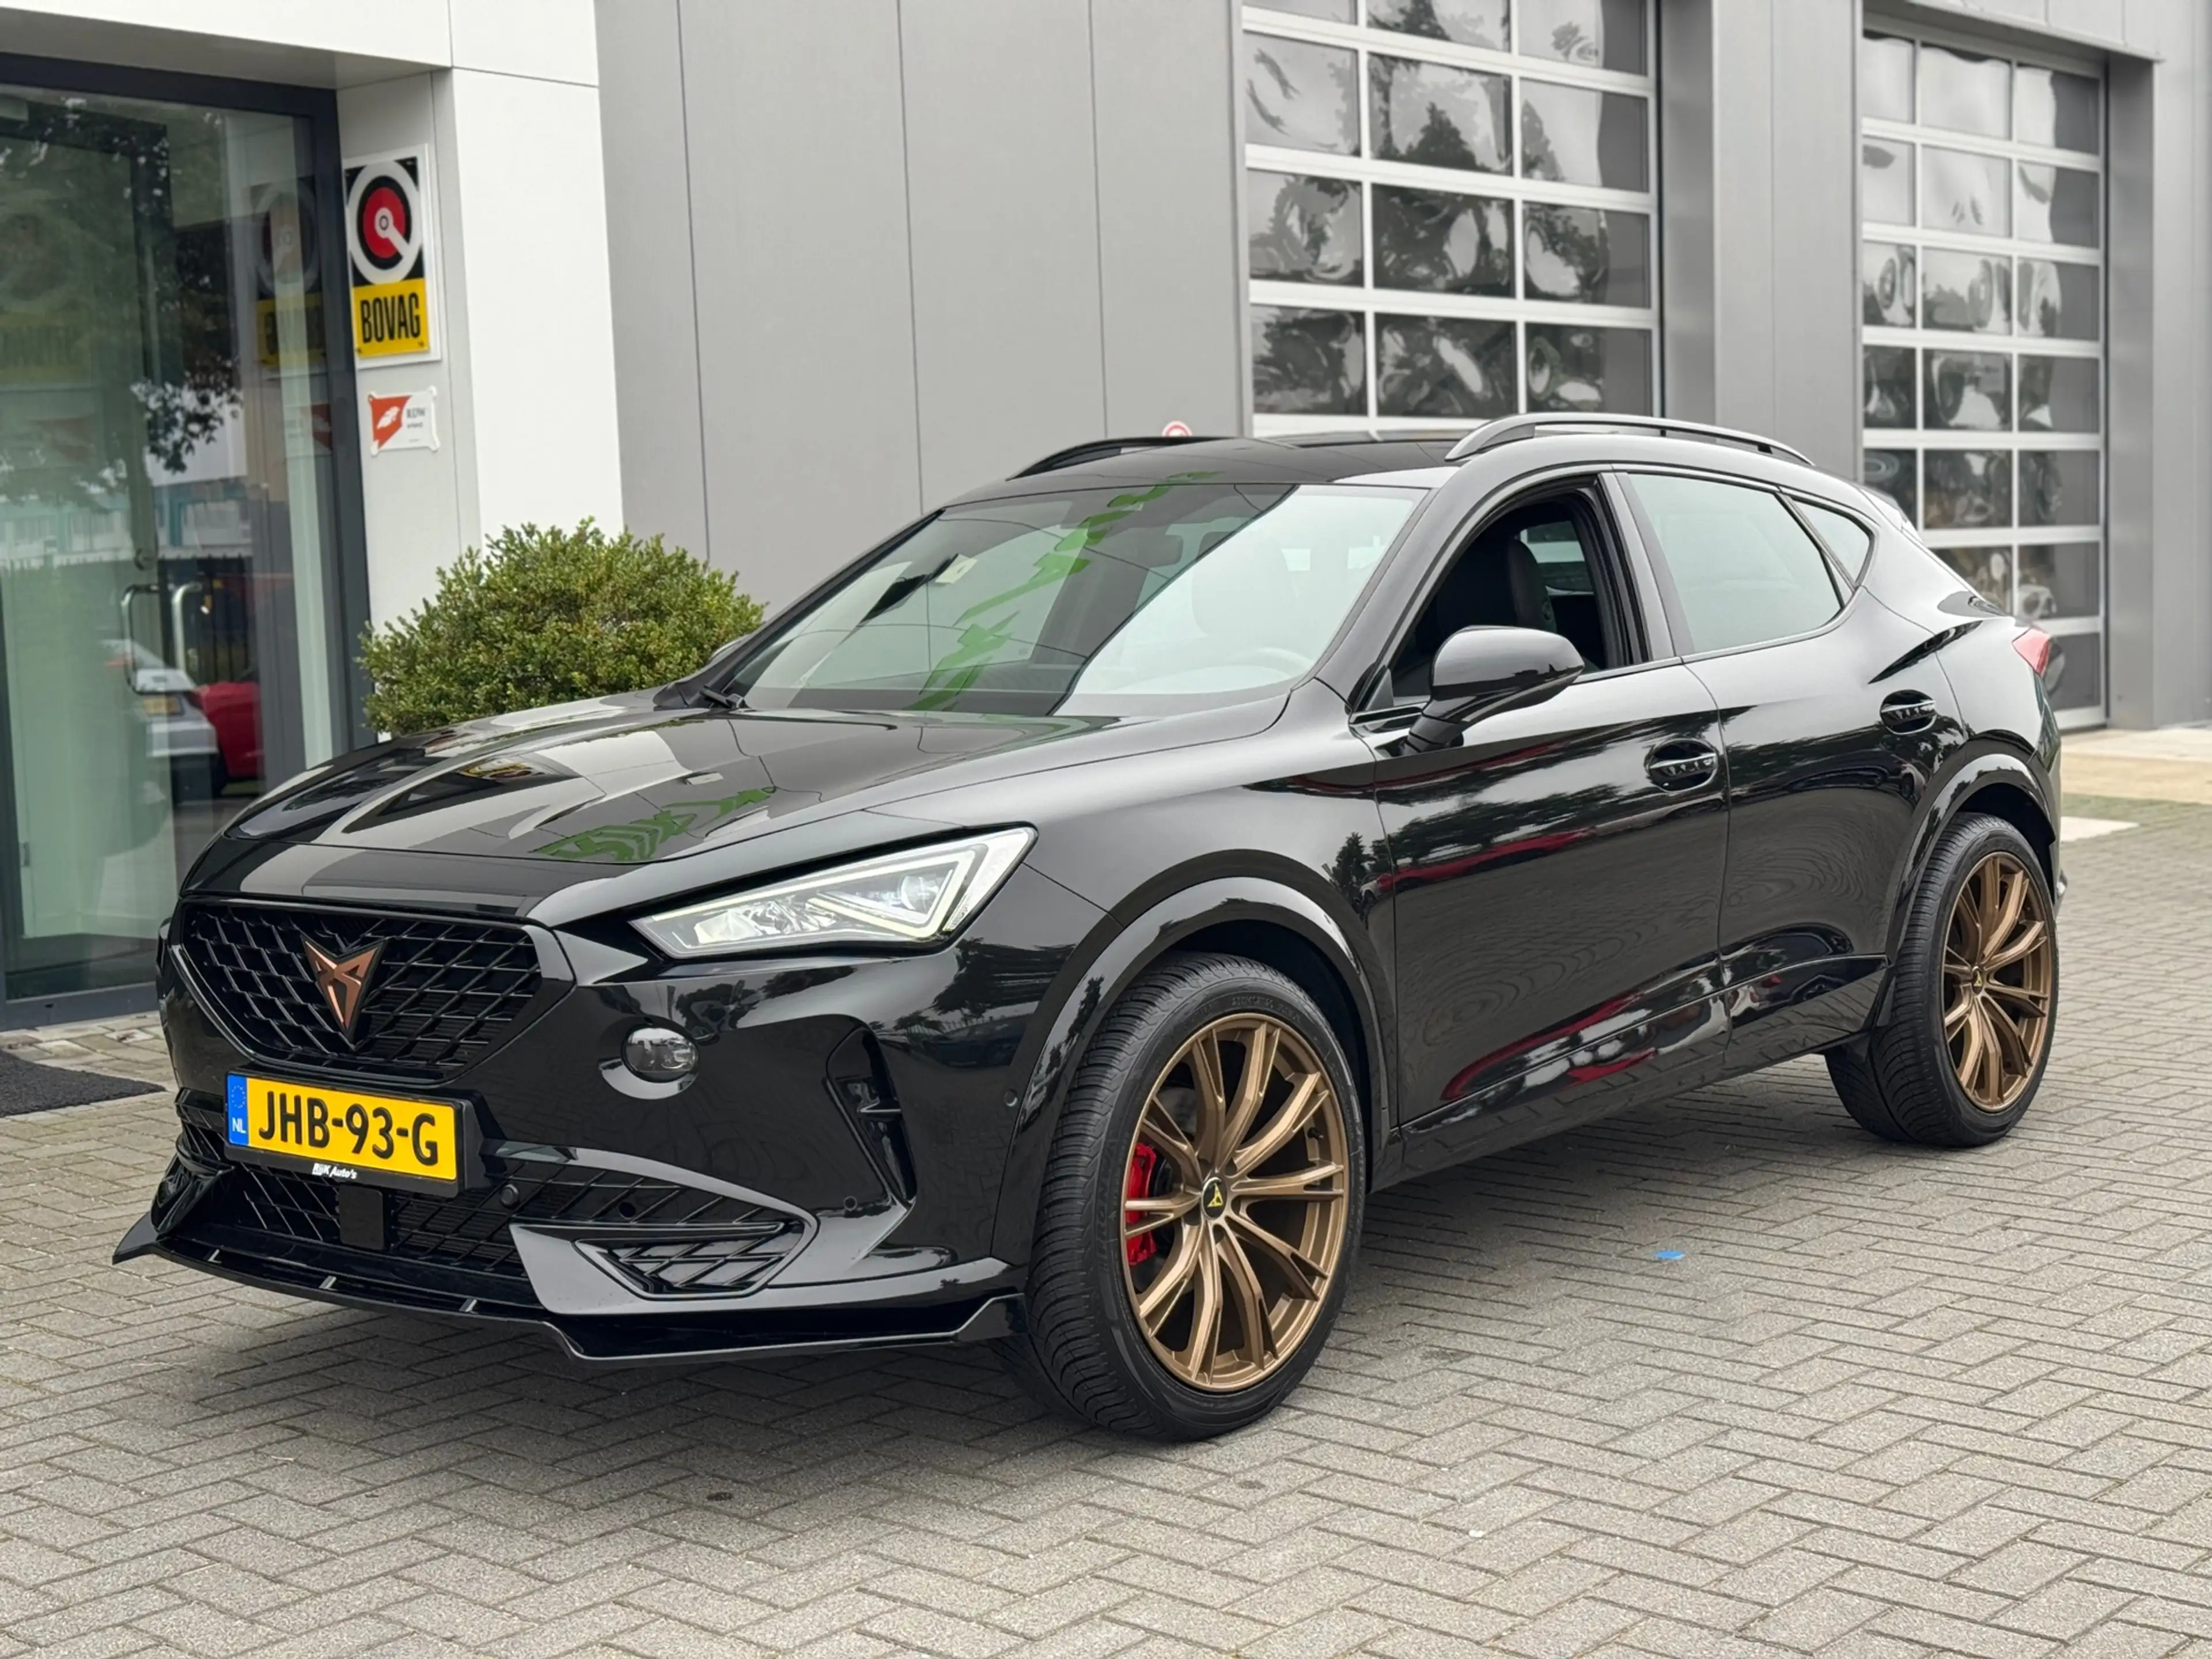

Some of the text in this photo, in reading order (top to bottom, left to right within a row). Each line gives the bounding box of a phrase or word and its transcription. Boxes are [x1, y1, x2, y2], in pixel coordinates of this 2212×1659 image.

[360, 292, 420, 343] BOVAG
[232, 1118, 247, 1134] NL
[259, 1091, 438, 1166] JHB-93-G
